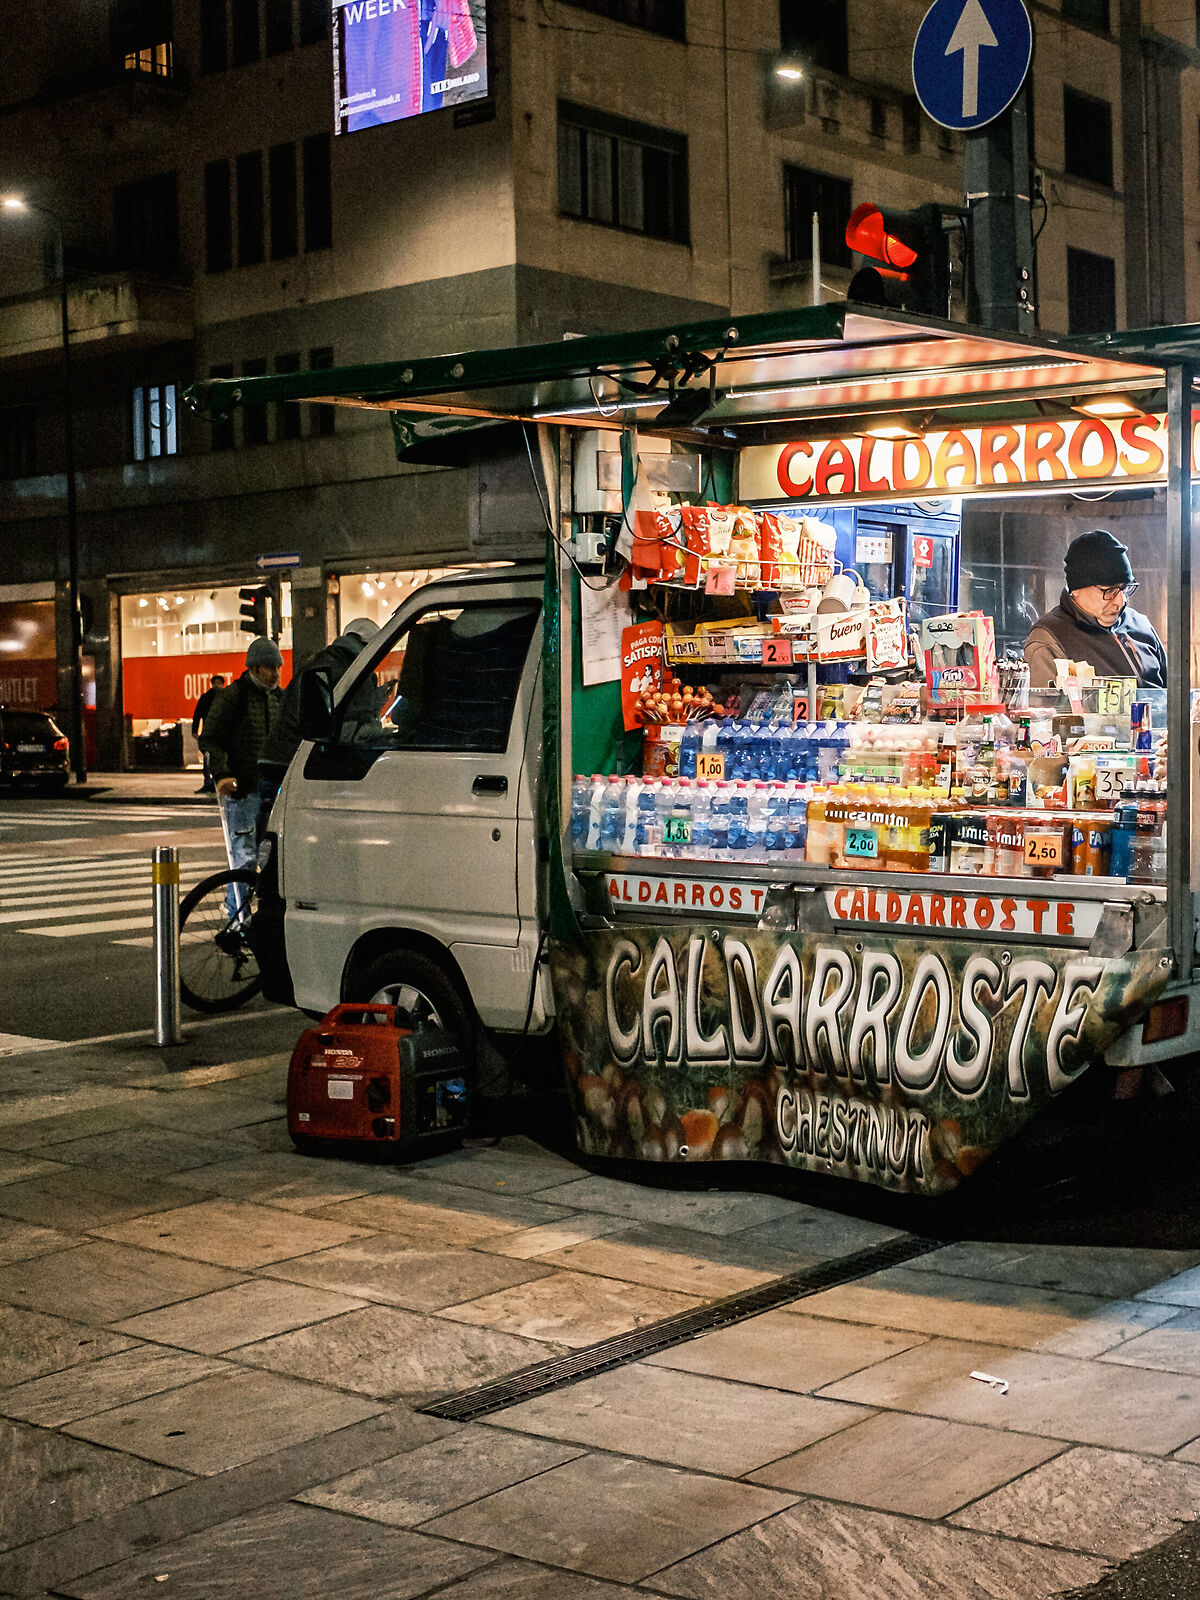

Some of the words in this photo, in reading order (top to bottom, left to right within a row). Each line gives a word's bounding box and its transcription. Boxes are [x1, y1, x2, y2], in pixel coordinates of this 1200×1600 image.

[830, 622, 861, 640] bueno
[624, 645, 663, 668] SATISPA
[699, 757, 722, 776] 1,00
[849, 832, 875, 852] 2,00
[1028, 840, 1057, 861] 2,50
[608, 878, 764, 912] ALDARROST
[833, 888, 1075, 935] CALDARROSTE
[606, 935, 1103, 1100] CALDARROSTE
[777, 1086, 932, 1180] CHESTNUT
